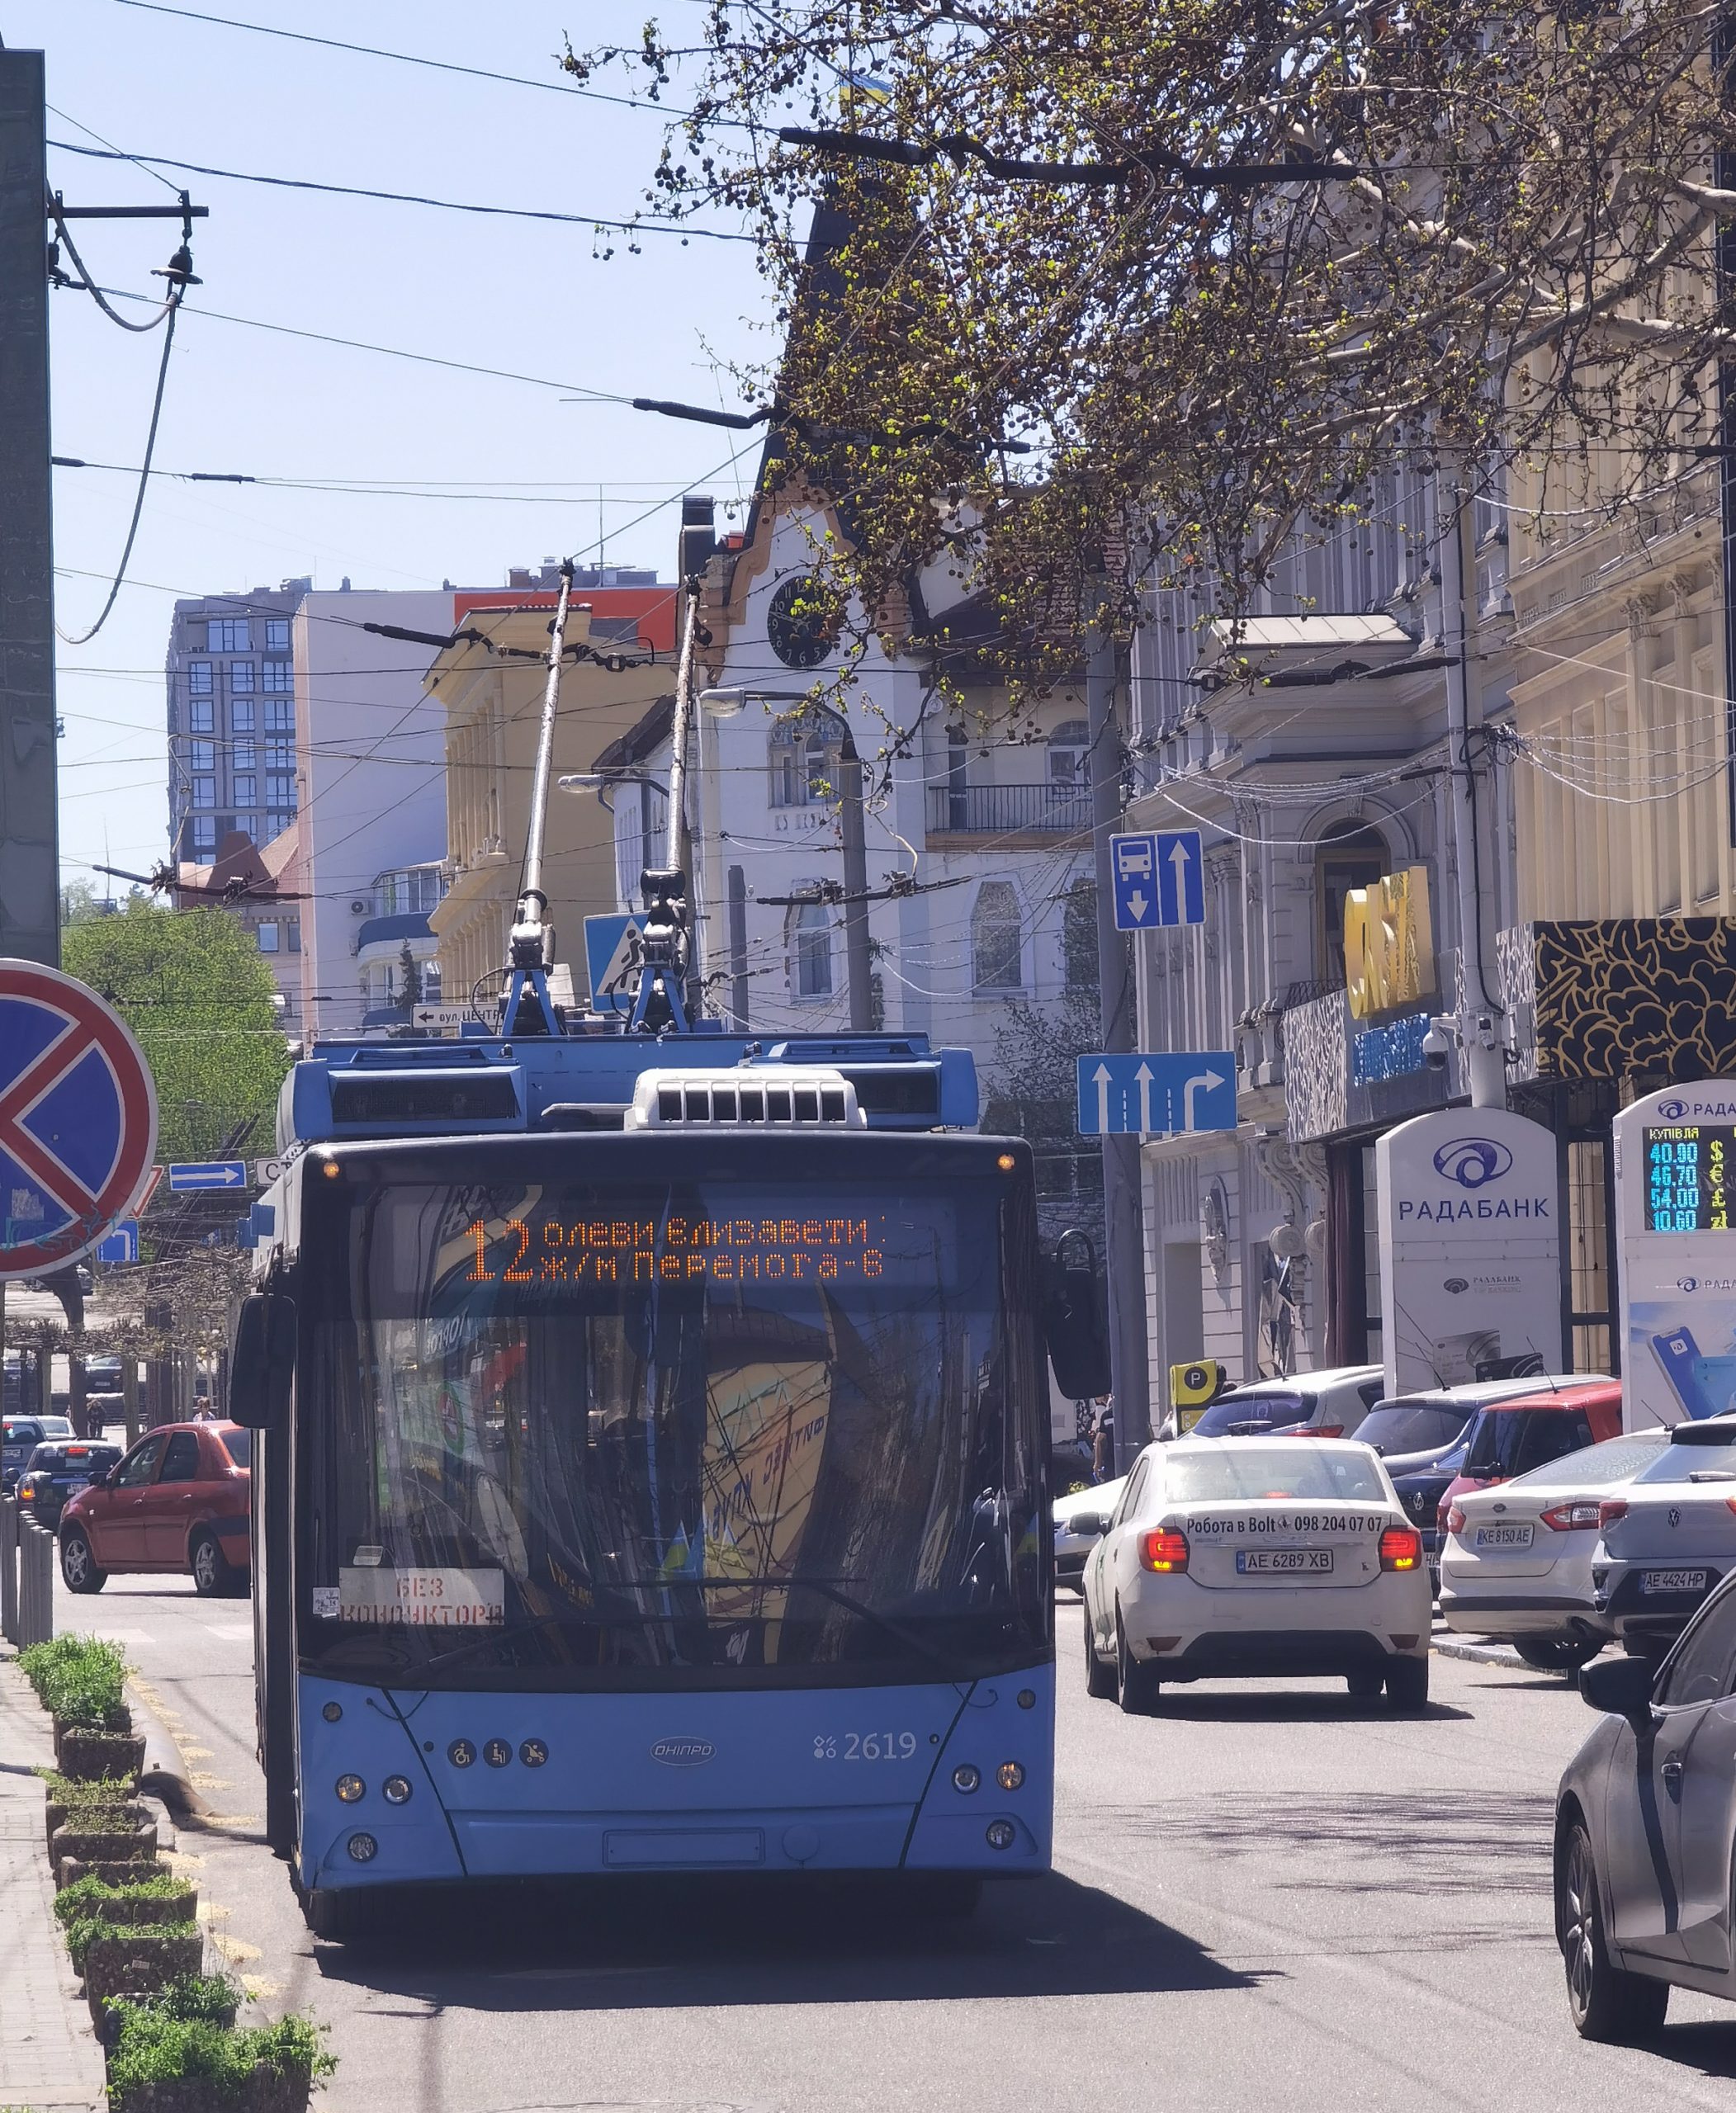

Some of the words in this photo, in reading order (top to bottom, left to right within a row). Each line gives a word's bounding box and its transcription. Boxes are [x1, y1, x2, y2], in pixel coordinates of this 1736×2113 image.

[1650, 1142, 1698, 1163] 40.90
[1399, 1198, 1549, 1223] РАДАБАНК
[464, 1220, 532, 1280] 12
[634, 1249, 882, 1280] Перемога-6
[1187, 1517, 1233, 1534] Робота
[1238, 1521, 1245, 1533] в
[1249, 1516, 1275, 1533] Bolt
[1294, 1516, 1318, 1531] 098
[1322, 1516, 1346, 1531] 204
[1349, 1517, 1364, 1532] 07
[1367, 1517, 1382, 1532] 07
[1517, 1529, 1530, 1542] AE
[1248, 1554, 1268, 1568] AE
[1272, 1553, 1304, 1567] 6289
[1308, 1553, 1329, 1567] XB
[397, 1577, 443, 1597] БЕЗ
[1646, 1574, 1660, 1586] AE
[844, 1732, 916, 1760] 2619
